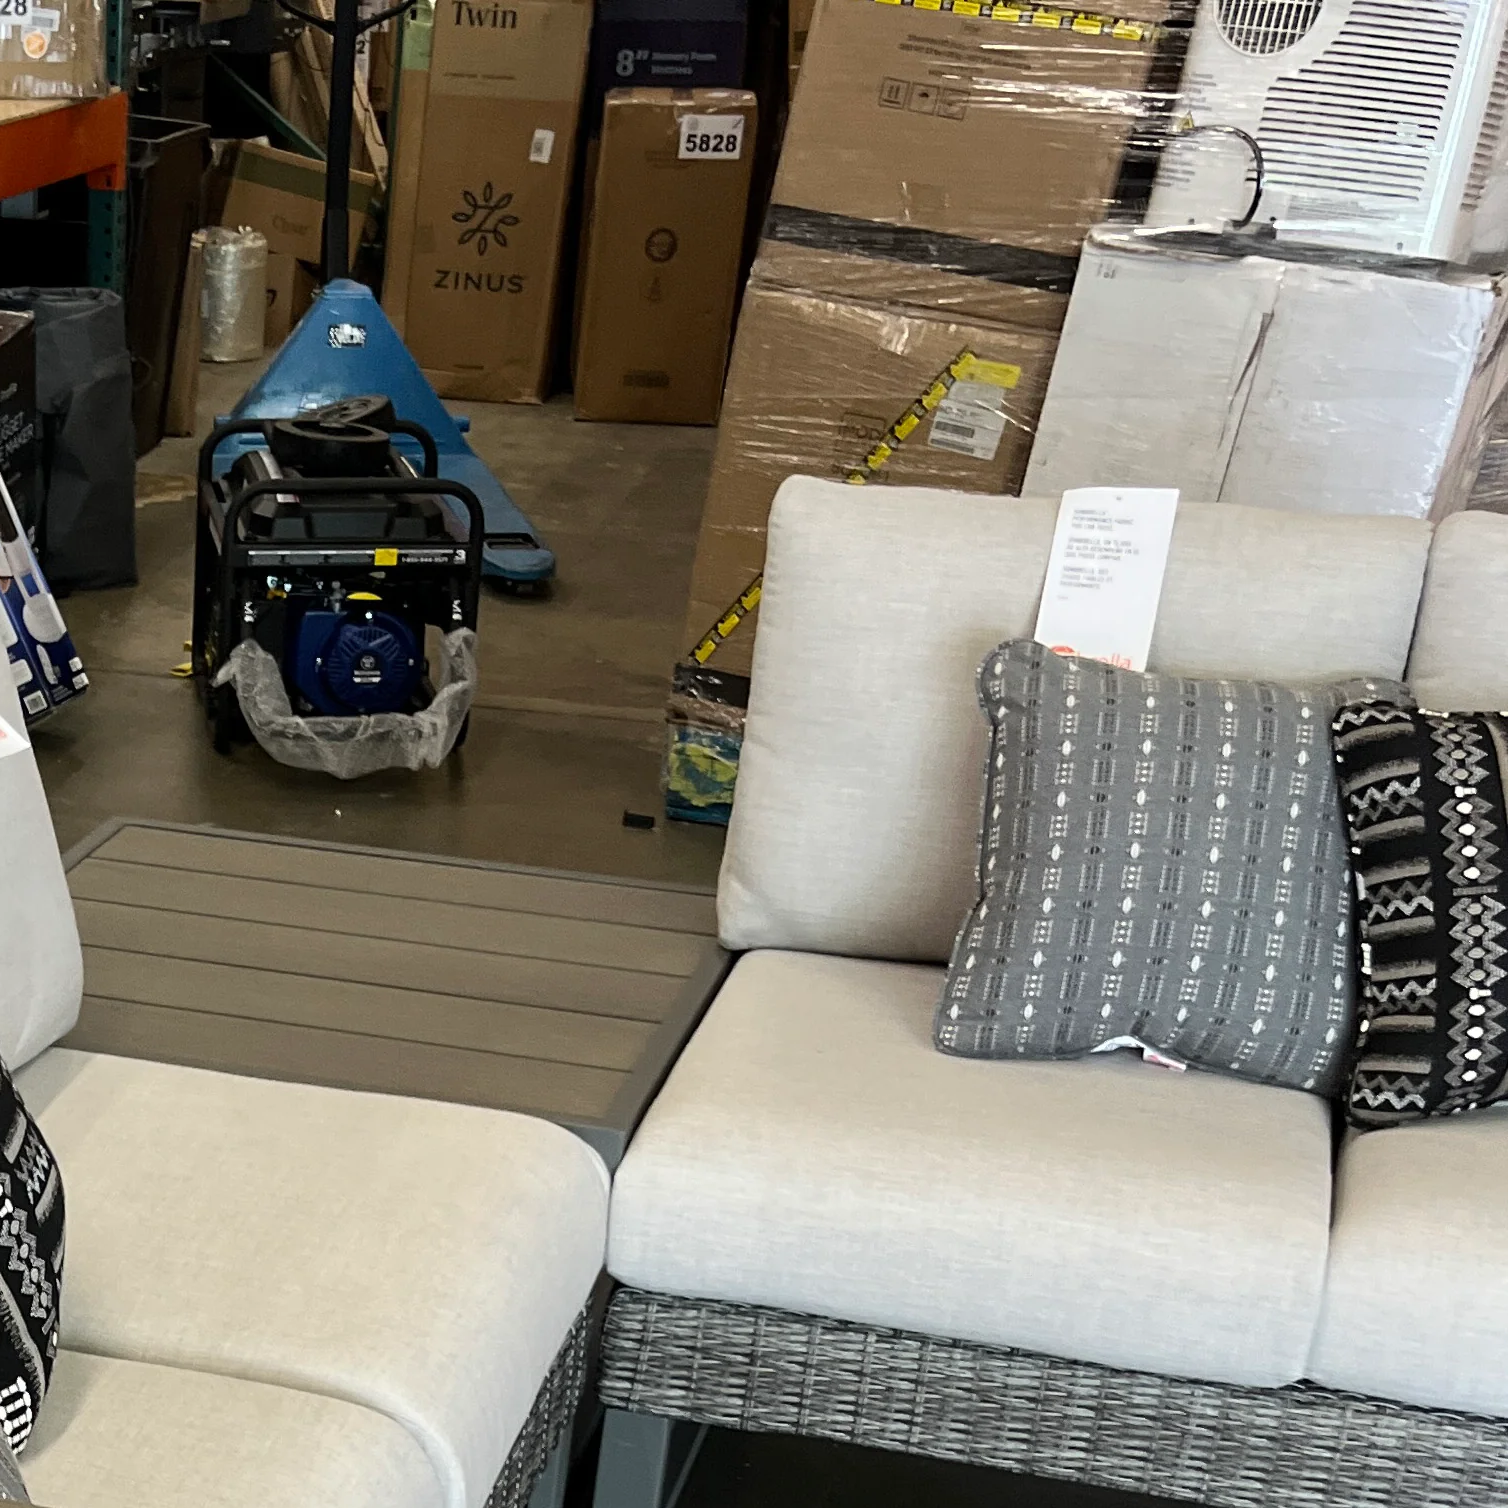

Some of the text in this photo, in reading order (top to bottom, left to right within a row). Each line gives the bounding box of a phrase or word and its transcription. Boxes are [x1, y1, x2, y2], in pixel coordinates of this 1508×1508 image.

[452, 1, 517, 29] Twin
[685, 133, 738, 152] 5828
[434, 269, 525, 294] ZINUS
